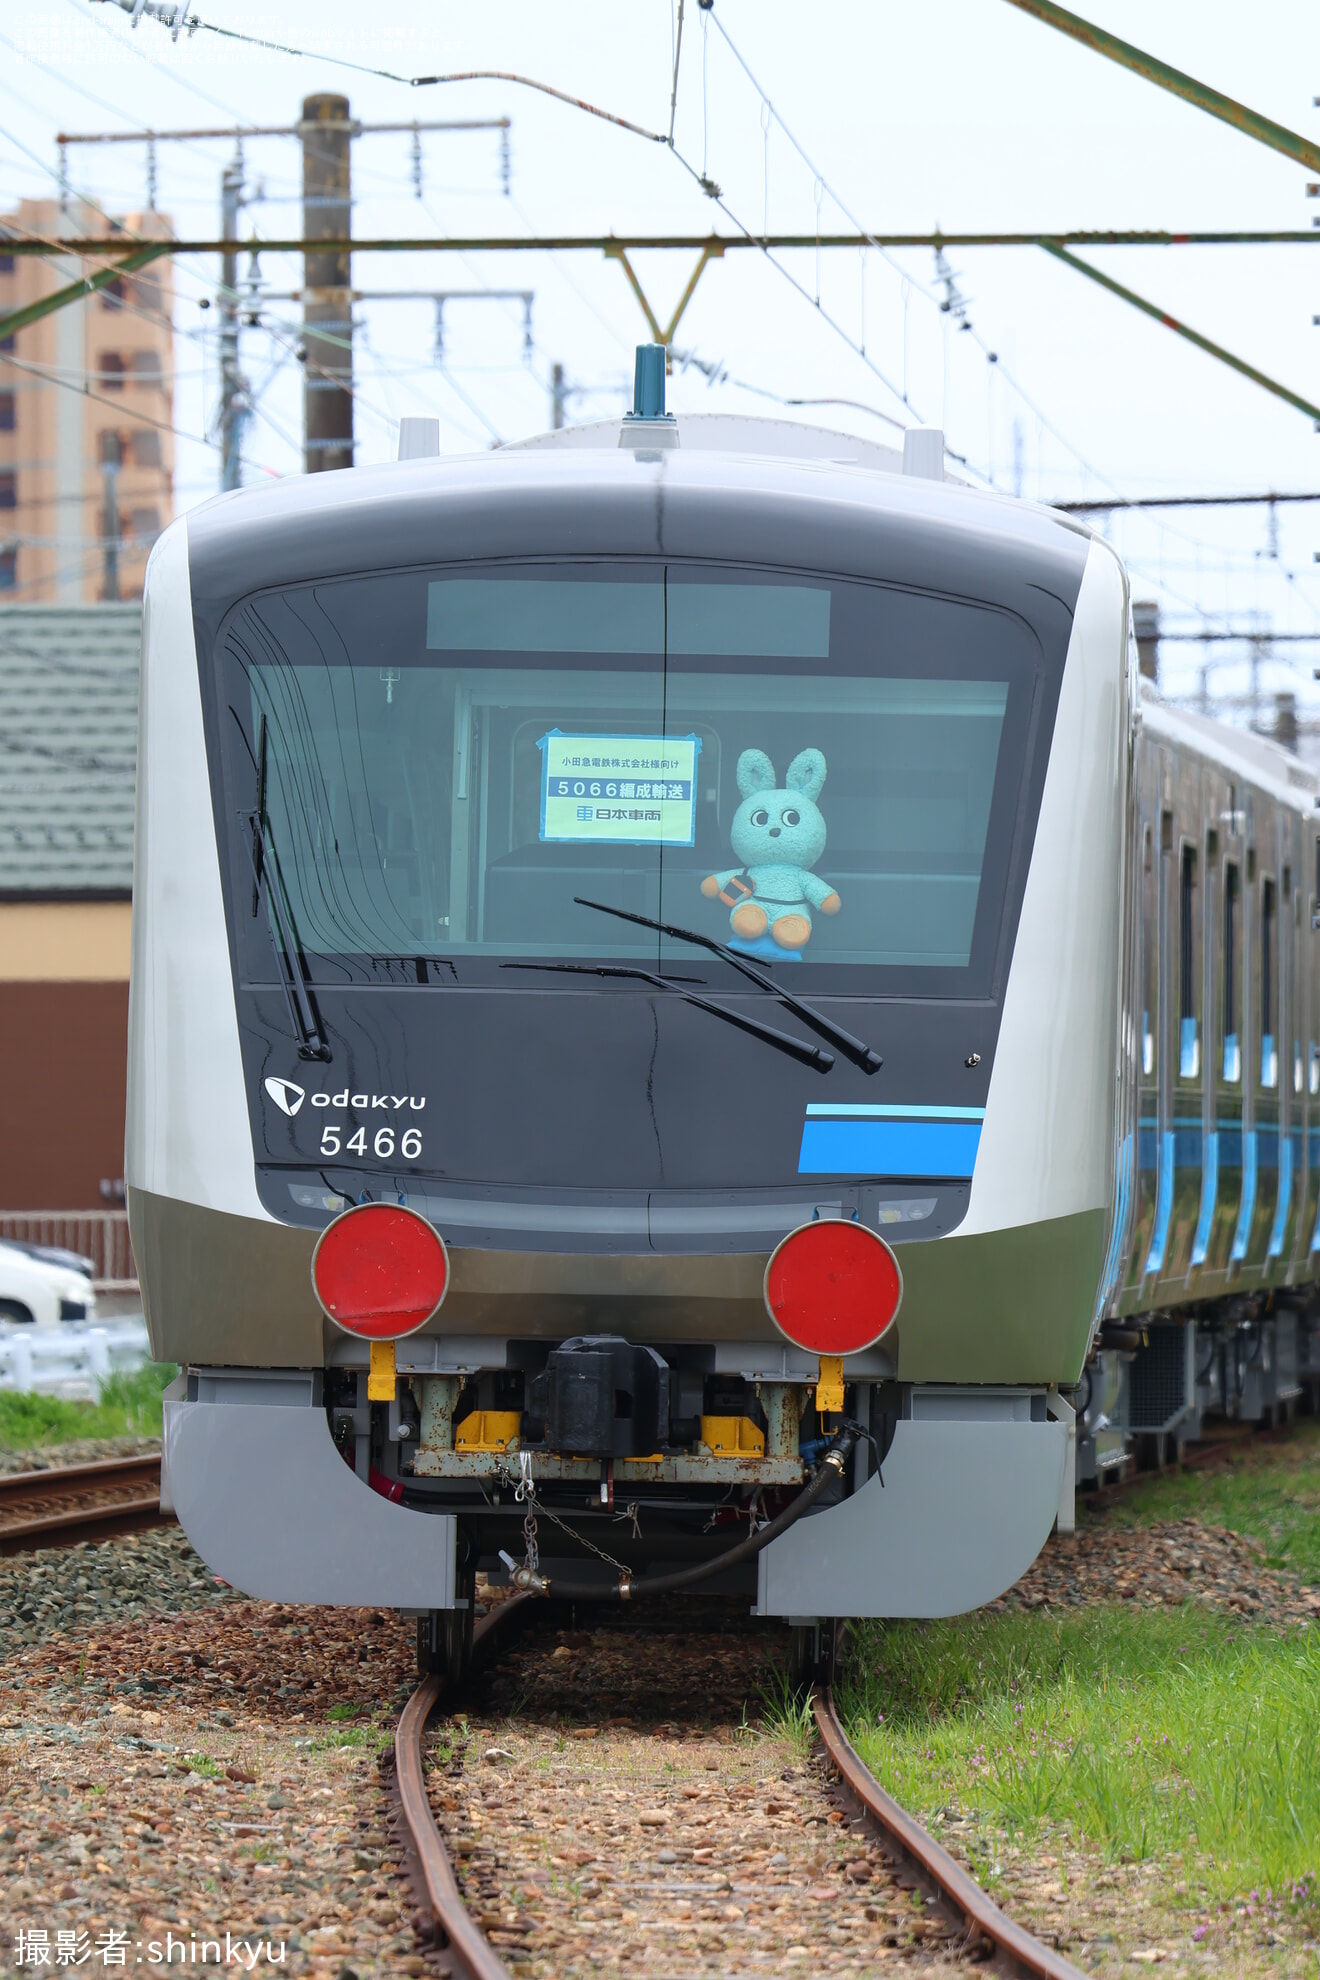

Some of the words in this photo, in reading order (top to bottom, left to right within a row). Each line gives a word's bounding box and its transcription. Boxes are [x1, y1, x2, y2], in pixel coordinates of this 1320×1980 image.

[562, 757, 679, 769] 小田急電鉄株式会社様向け
[319, 1126, 423, 1159] 5466
